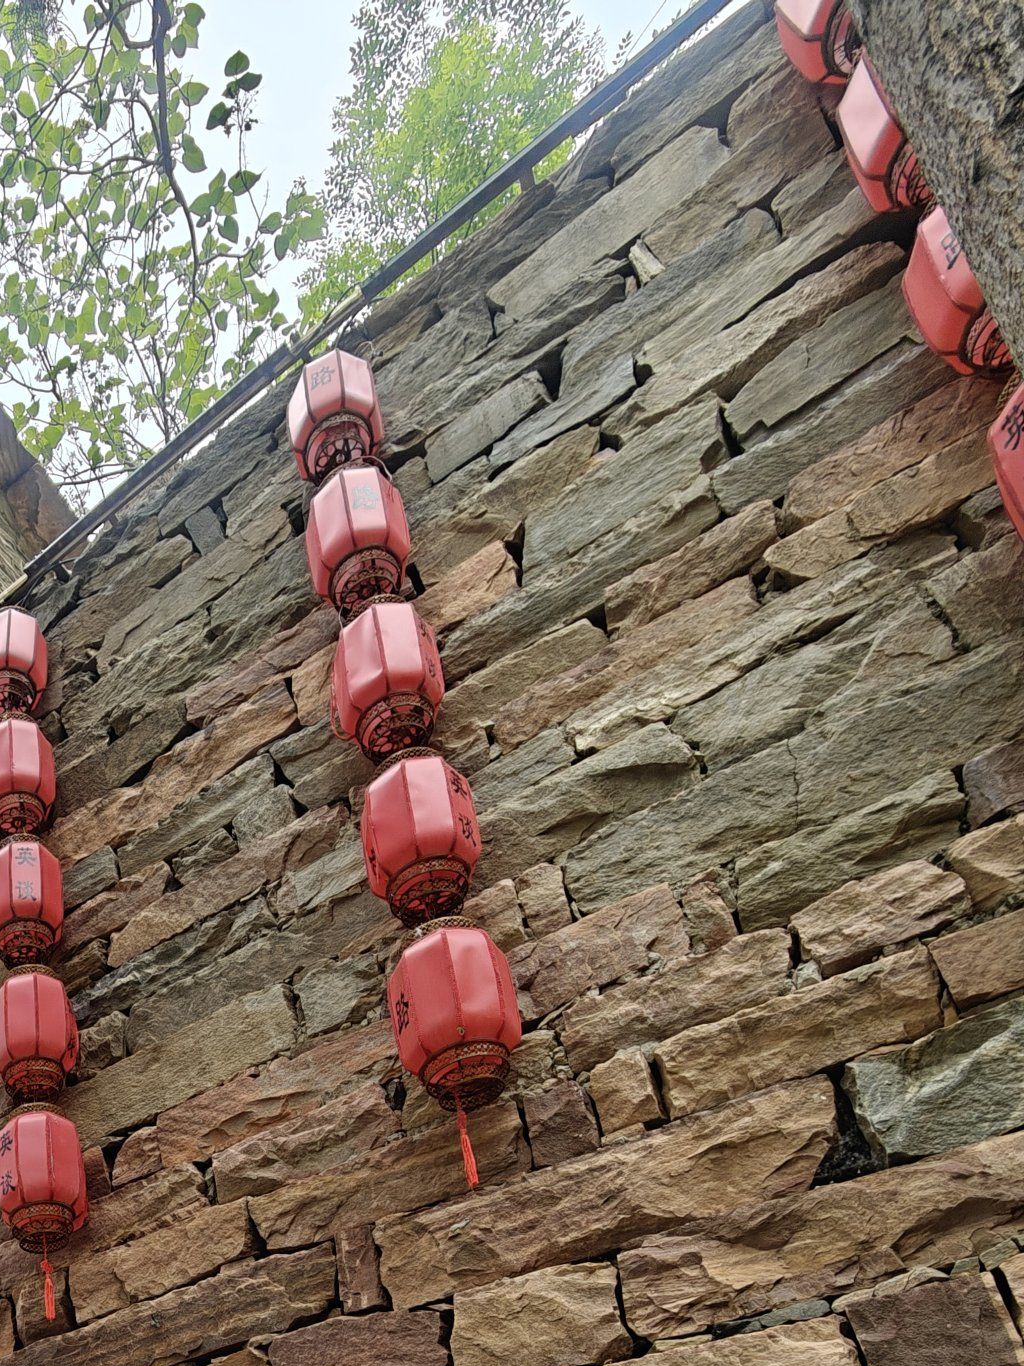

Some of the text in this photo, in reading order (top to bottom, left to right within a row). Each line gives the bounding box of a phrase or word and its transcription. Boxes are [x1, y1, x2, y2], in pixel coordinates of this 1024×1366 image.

[450, 770, 476, 847] 英谈
[15, 847, 36, 901] 英谈
[0, 1130, 16, 1195] 英谈
